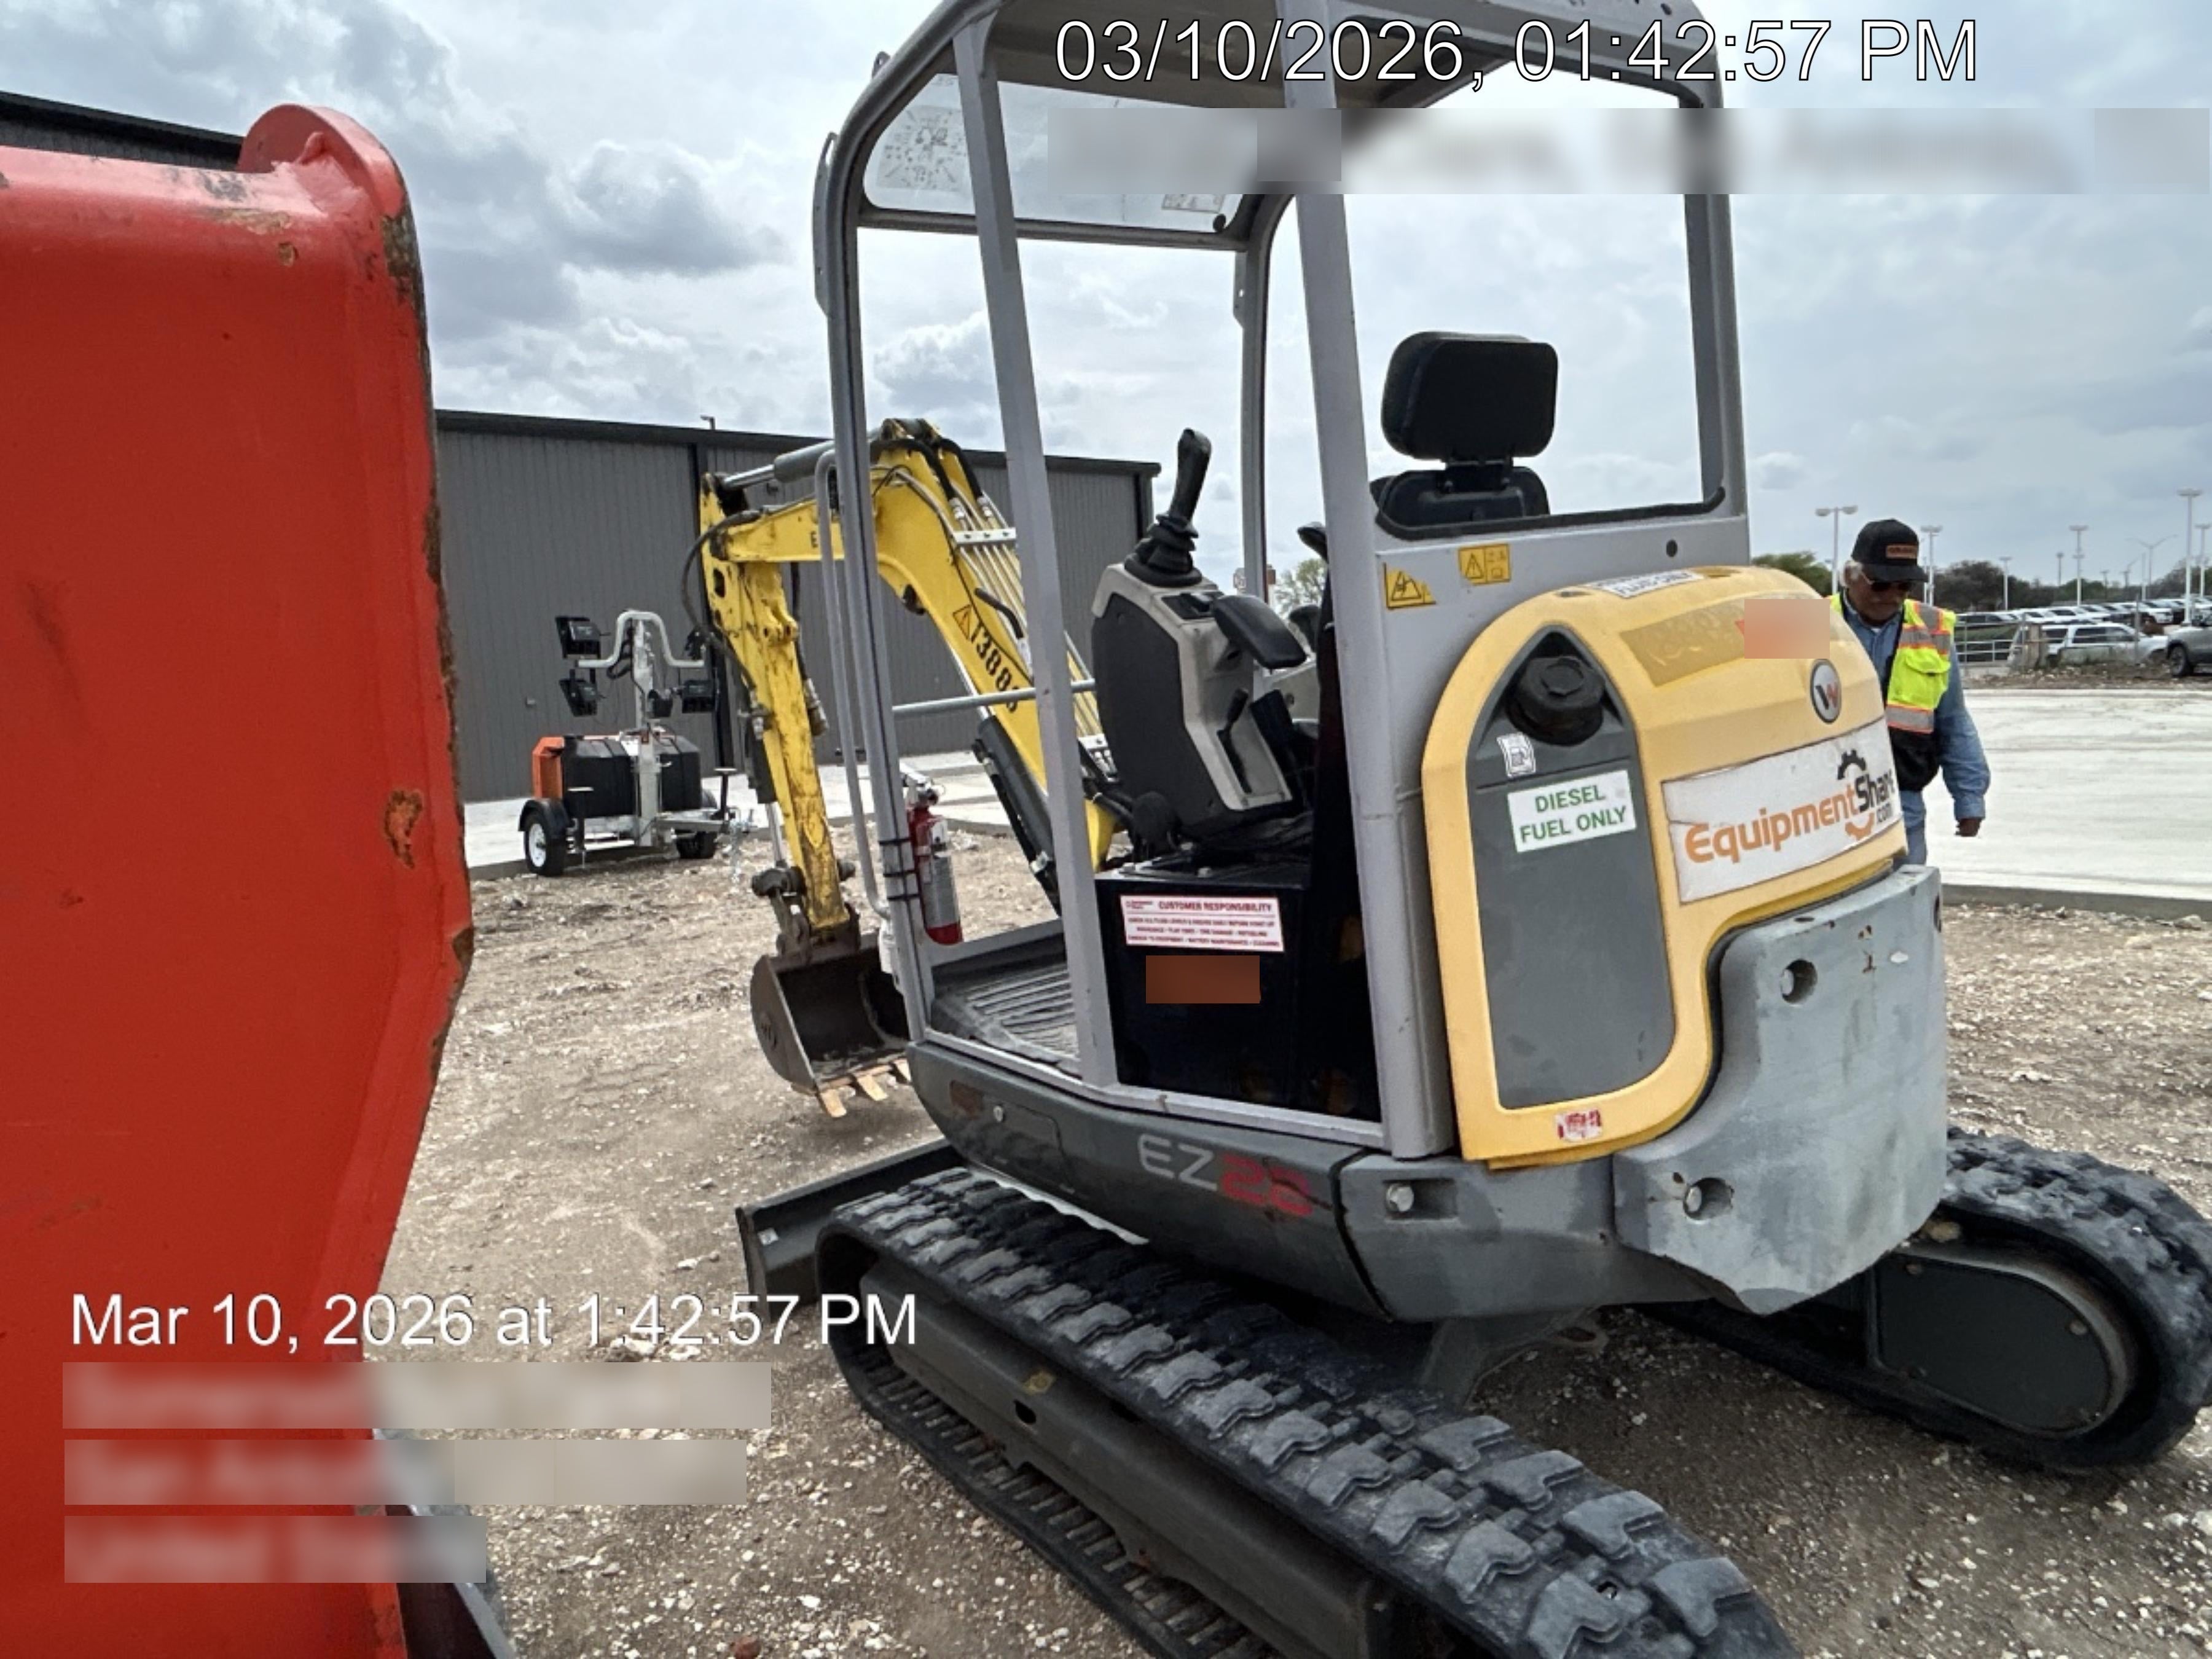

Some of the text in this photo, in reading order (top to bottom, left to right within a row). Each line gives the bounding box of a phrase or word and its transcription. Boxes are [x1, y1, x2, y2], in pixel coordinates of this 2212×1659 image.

[1535, 785, 1606, 814] DIESEL
[1519, 805, 1626, 844] FUEL ONLY
[1158, 901, 1202, 911] CUSTOMER
[1203, 902, 1272, 912] RESPONSIBILITY
